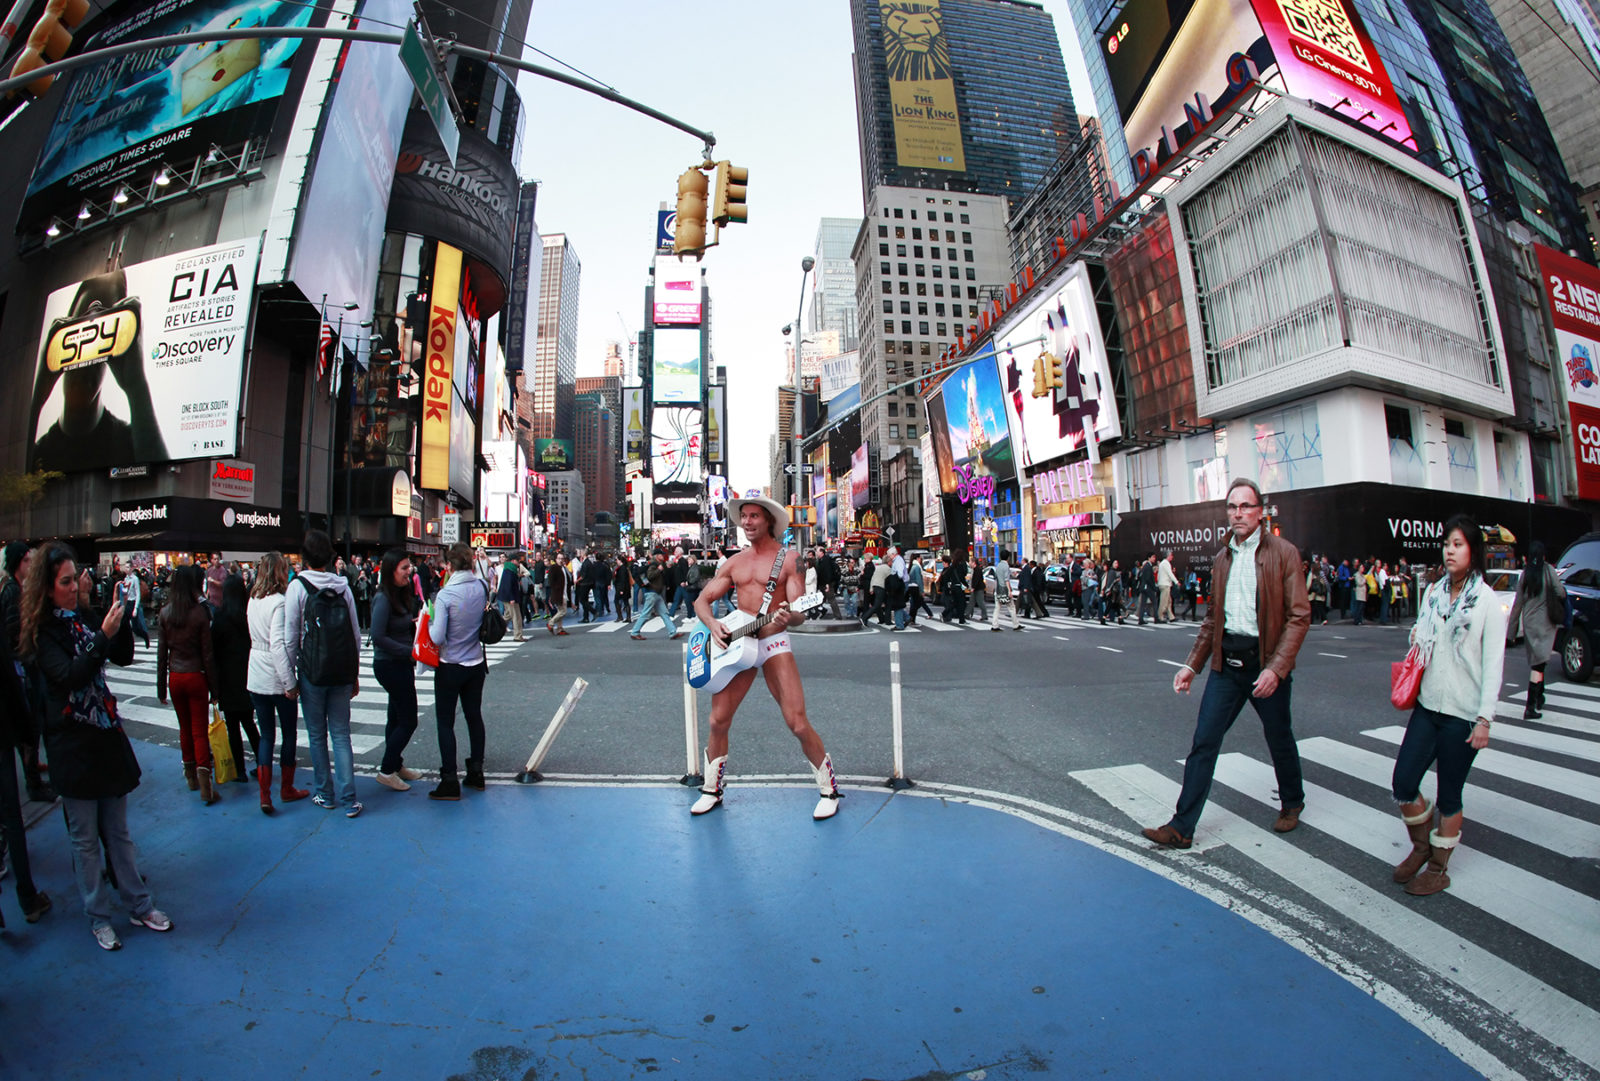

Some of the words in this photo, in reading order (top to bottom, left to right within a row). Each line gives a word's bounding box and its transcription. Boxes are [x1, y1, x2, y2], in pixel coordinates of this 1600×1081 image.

[106, 15, 152, 44] OPENING
[154, 2, 178, 19] THIS
[135, 6, 155, 21] THE
[1117, 22, 1130, 43] LG
[1296, 45, 1314, 61] LG
[1314, 54, 1354, 82] Cinema
[913, 94, 934, 104] THE
[895, 104, 923, 117] LION
[926, 106, 956, 120] KING
[67, 157, 118, 187] Discovery
[120, 145, 147, 163] TIMES
[149, 127, 193, 151] SQUARE
[1051, 52, 1260, 264] BUILDING
[439, 184, 479, 207] driving
[175, 249, 245, 271] DECLASSIFIED
[169, 264, 239, 303] CIA
[1551, 275, 1567, 301] 2
[167, 300, 200, 313] ARTIFACTS
[208, 295, 236, 306] STORIES
[511, 266, 528, 350] SQUARE
[164, 305, 234, 328] REVEALED
[61, 318, 119, 365] SPY
[158, 335, 236, 360] Discovery
[156, 359, 174, 369] TIMES
[175, 355, 203, 366] SQUARE
[425, 304, 454, 424] Kodak
[182, 403, 192, 414] ONE
[193, 402, 210, 412] BLOCK
[211, 400, 229, 411] SOUTH
[203, 440, 226, 449] BASE
[213, 462, 254, 483] Marriott
[1033, 459, 1097, 506] FOREVER
[121, 505, 153, 525] sunglass
[153, 503, 168, 519] hut
[236, 511, 268, 528] sunglass
[268, 512, 281, 528] hut
[1150, 528, 1212, 546] VORNADO
[1388, 518, 1444, 539] VORNA
